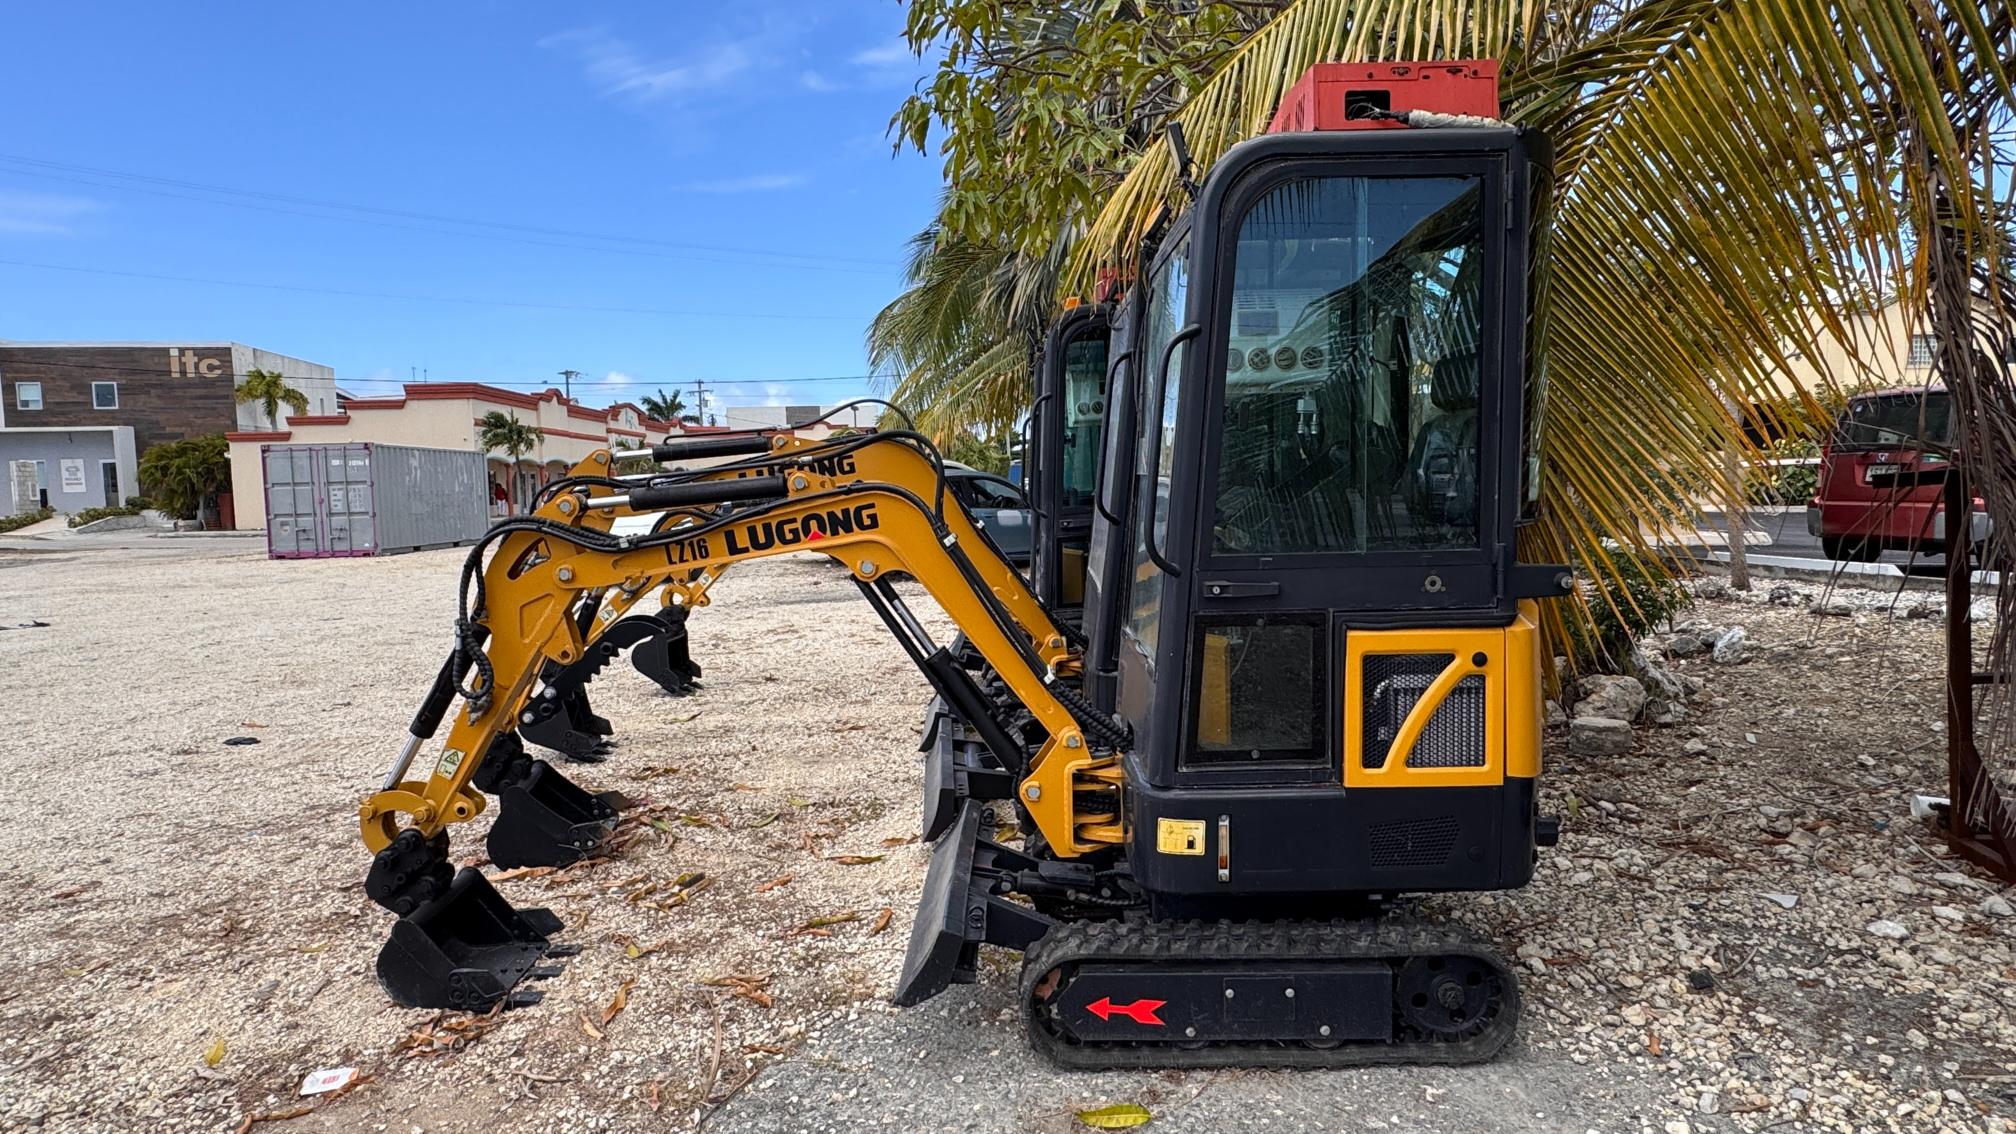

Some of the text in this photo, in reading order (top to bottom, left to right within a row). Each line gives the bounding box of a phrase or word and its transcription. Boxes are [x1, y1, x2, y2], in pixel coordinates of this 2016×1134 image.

[169, 348, 222, 378] itc
[664, 502, 880, 566] LZ16 LUGONG
